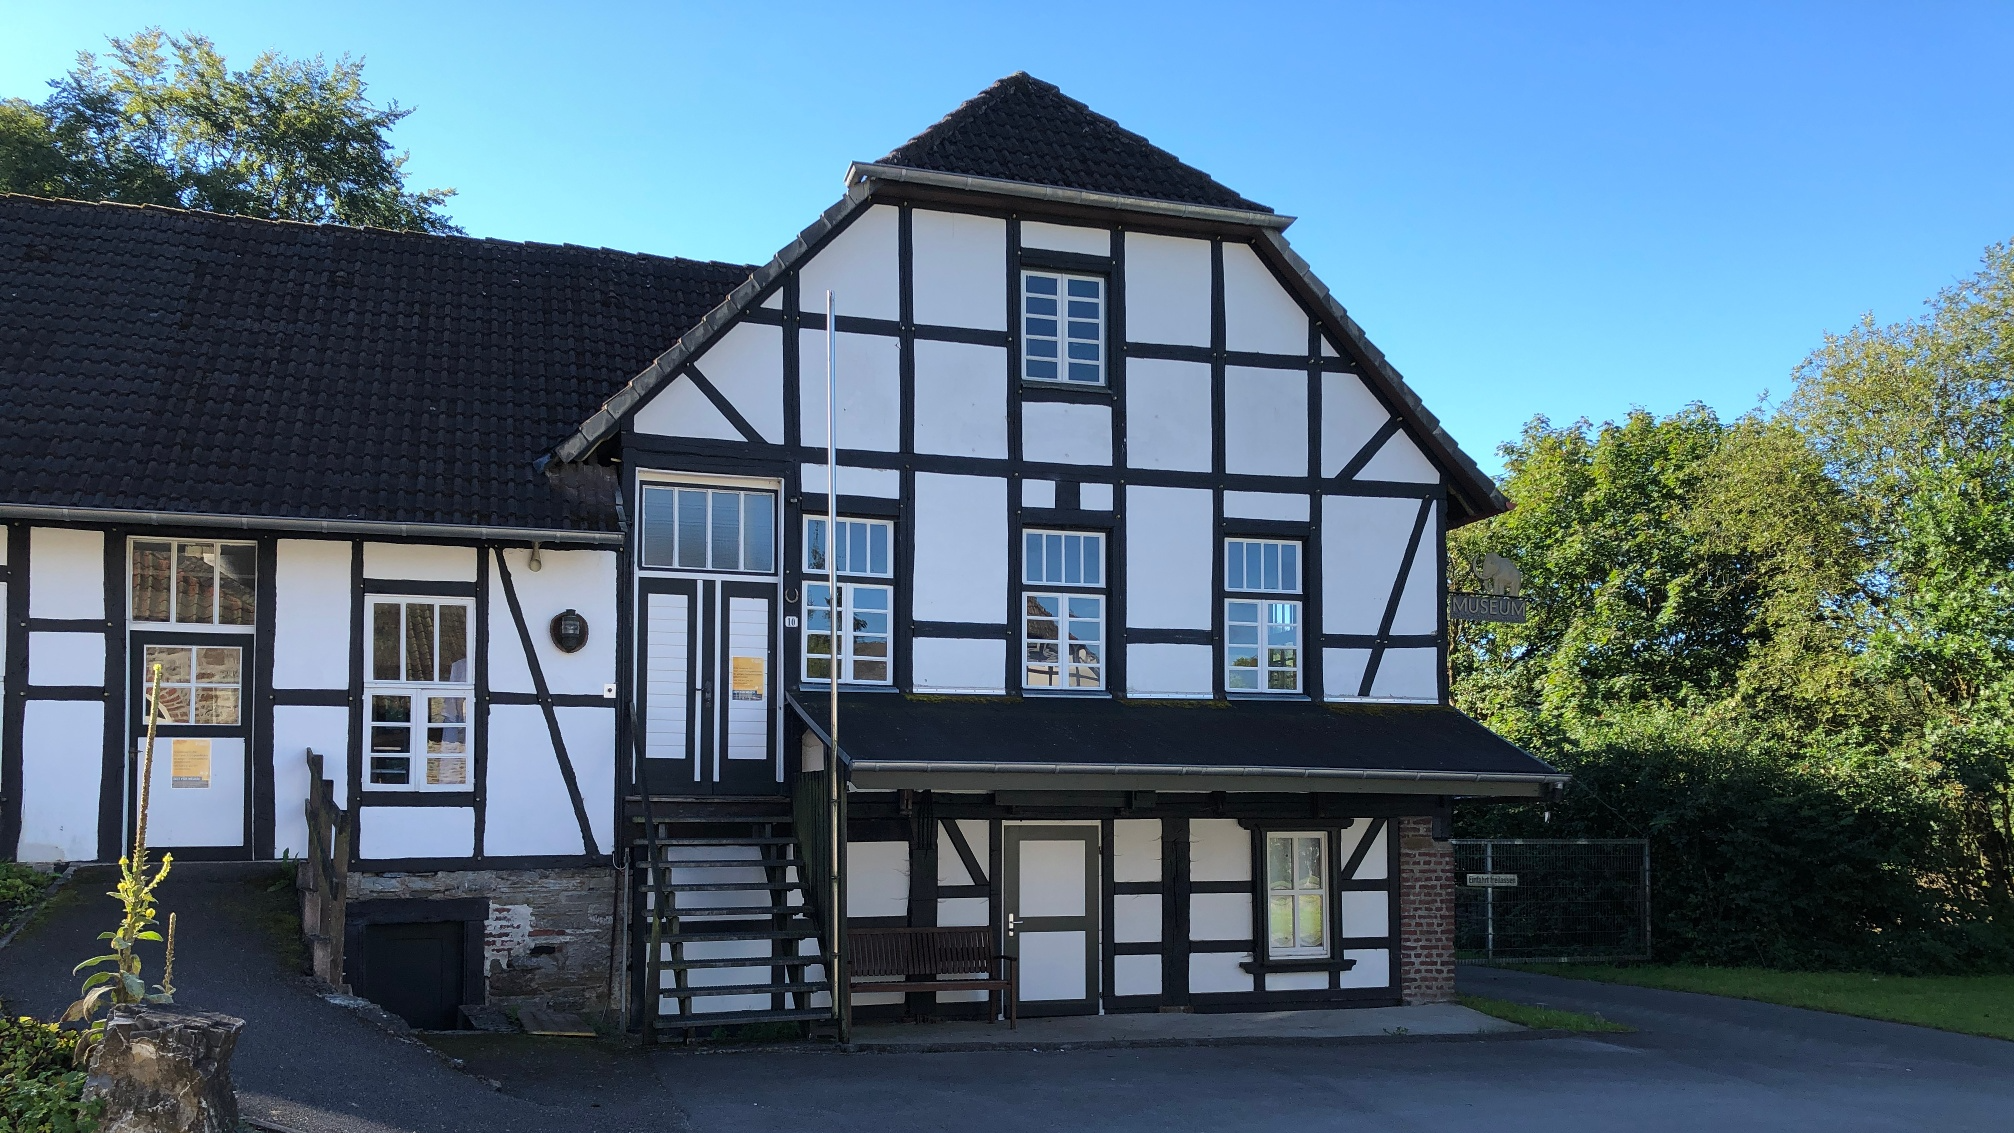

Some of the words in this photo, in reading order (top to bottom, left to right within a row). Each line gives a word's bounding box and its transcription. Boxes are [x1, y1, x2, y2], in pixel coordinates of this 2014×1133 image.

[1452, 597, 1526, 617] MUSEUM
[787, 617, 796, 626] 10
[1469, 875, 1489, 884] Einfahrt
